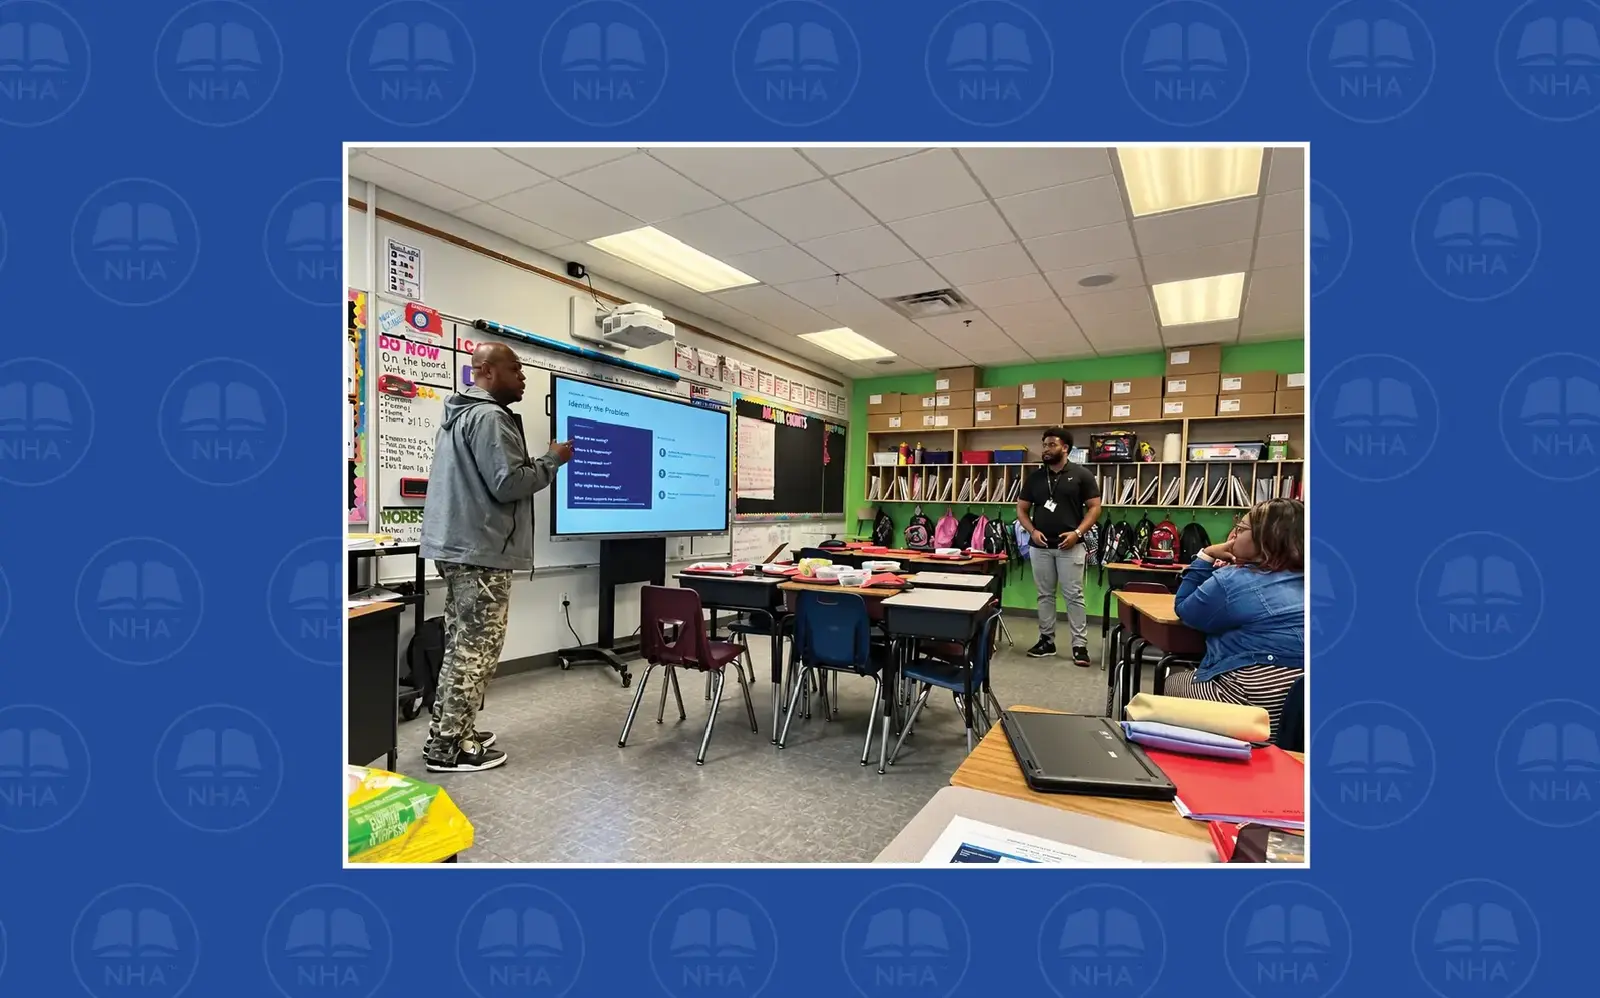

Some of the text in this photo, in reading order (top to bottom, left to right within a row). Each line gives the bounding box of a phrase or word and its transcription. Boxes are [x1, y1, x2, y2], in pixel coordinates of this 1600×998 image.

[379, 335, 440, 360] DO NOW
[382, 351, 398, 364] On
[403, 356, 418, 367] the
[410, 368, 418, 377] in
[568, 400, 630, 417] Identify the Problem
